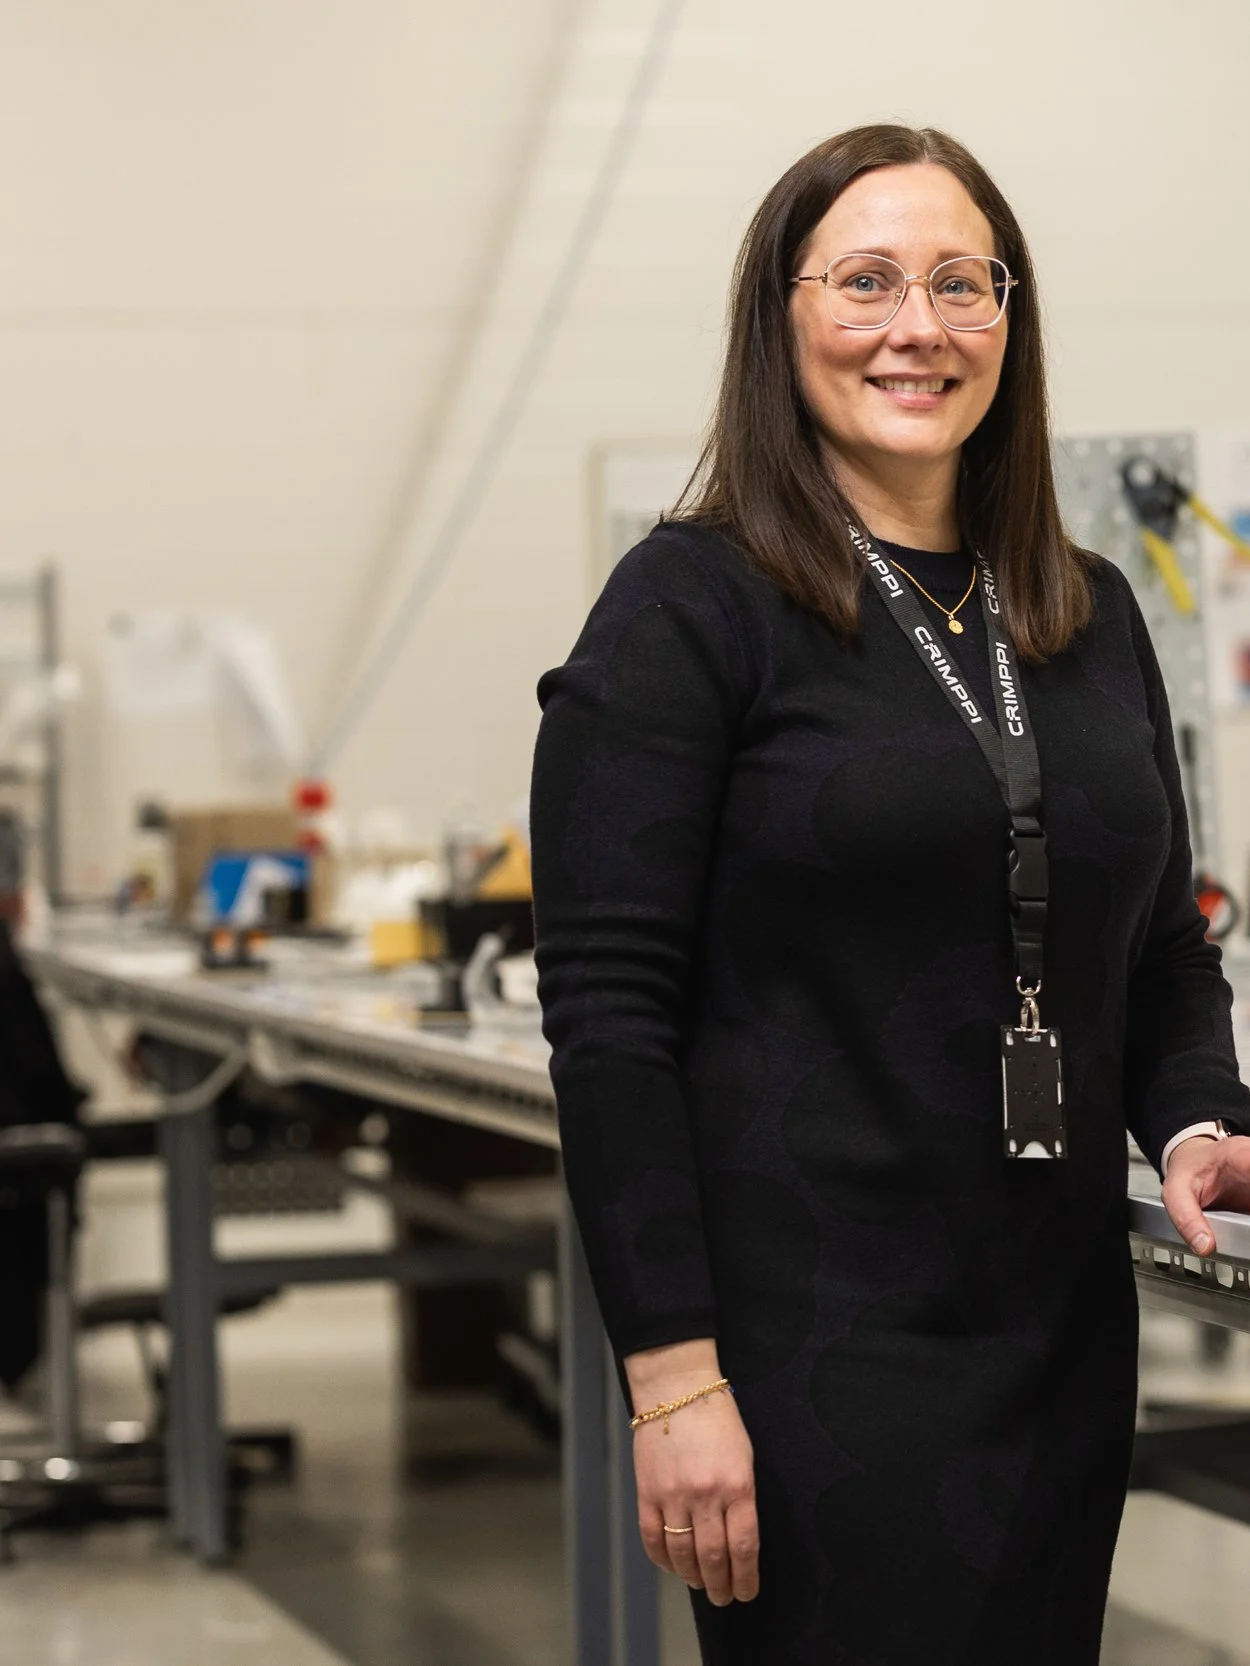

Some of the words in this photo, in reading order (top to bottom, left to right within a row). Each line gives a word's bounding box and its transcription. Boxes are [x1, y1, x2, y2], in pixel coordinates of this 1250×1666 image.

[845, 516, 904, 598] RIMPPI
[976, 549, 1000, 615] CRIM
[914, 626, 982, 724] CRIMPPI
[995, 641, 1025, 737] CRIMPPI
